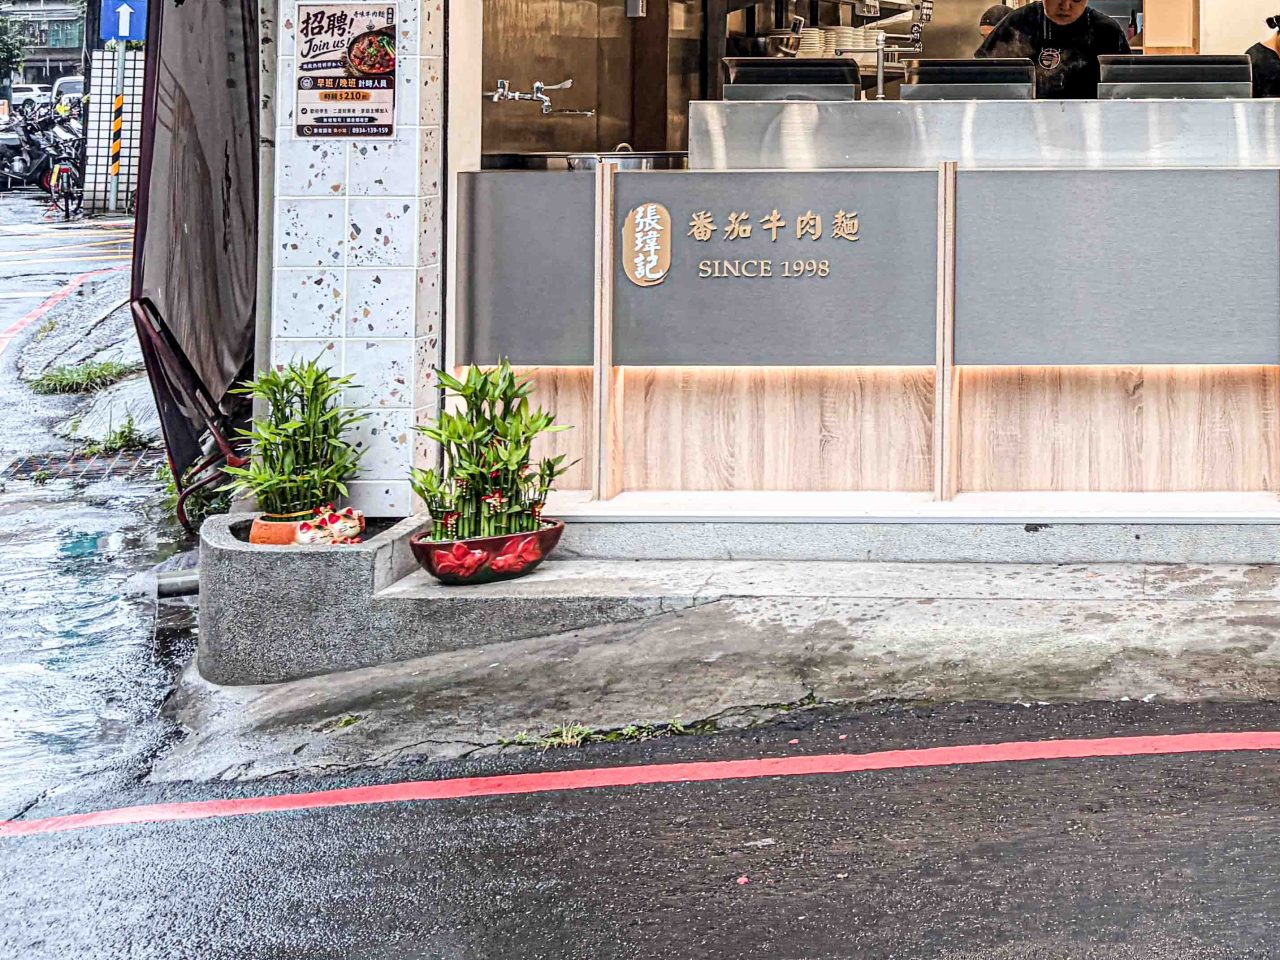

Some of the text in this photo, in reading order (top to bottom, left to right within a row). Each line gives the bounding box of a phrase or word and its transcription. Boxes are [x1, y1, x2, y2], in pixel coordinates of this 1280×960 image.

[300, 38, 330, 58] Join
[687, 208, 860, 242] 番茄牛肉麵
[698, 260, 830, 278] SINCE 1998
